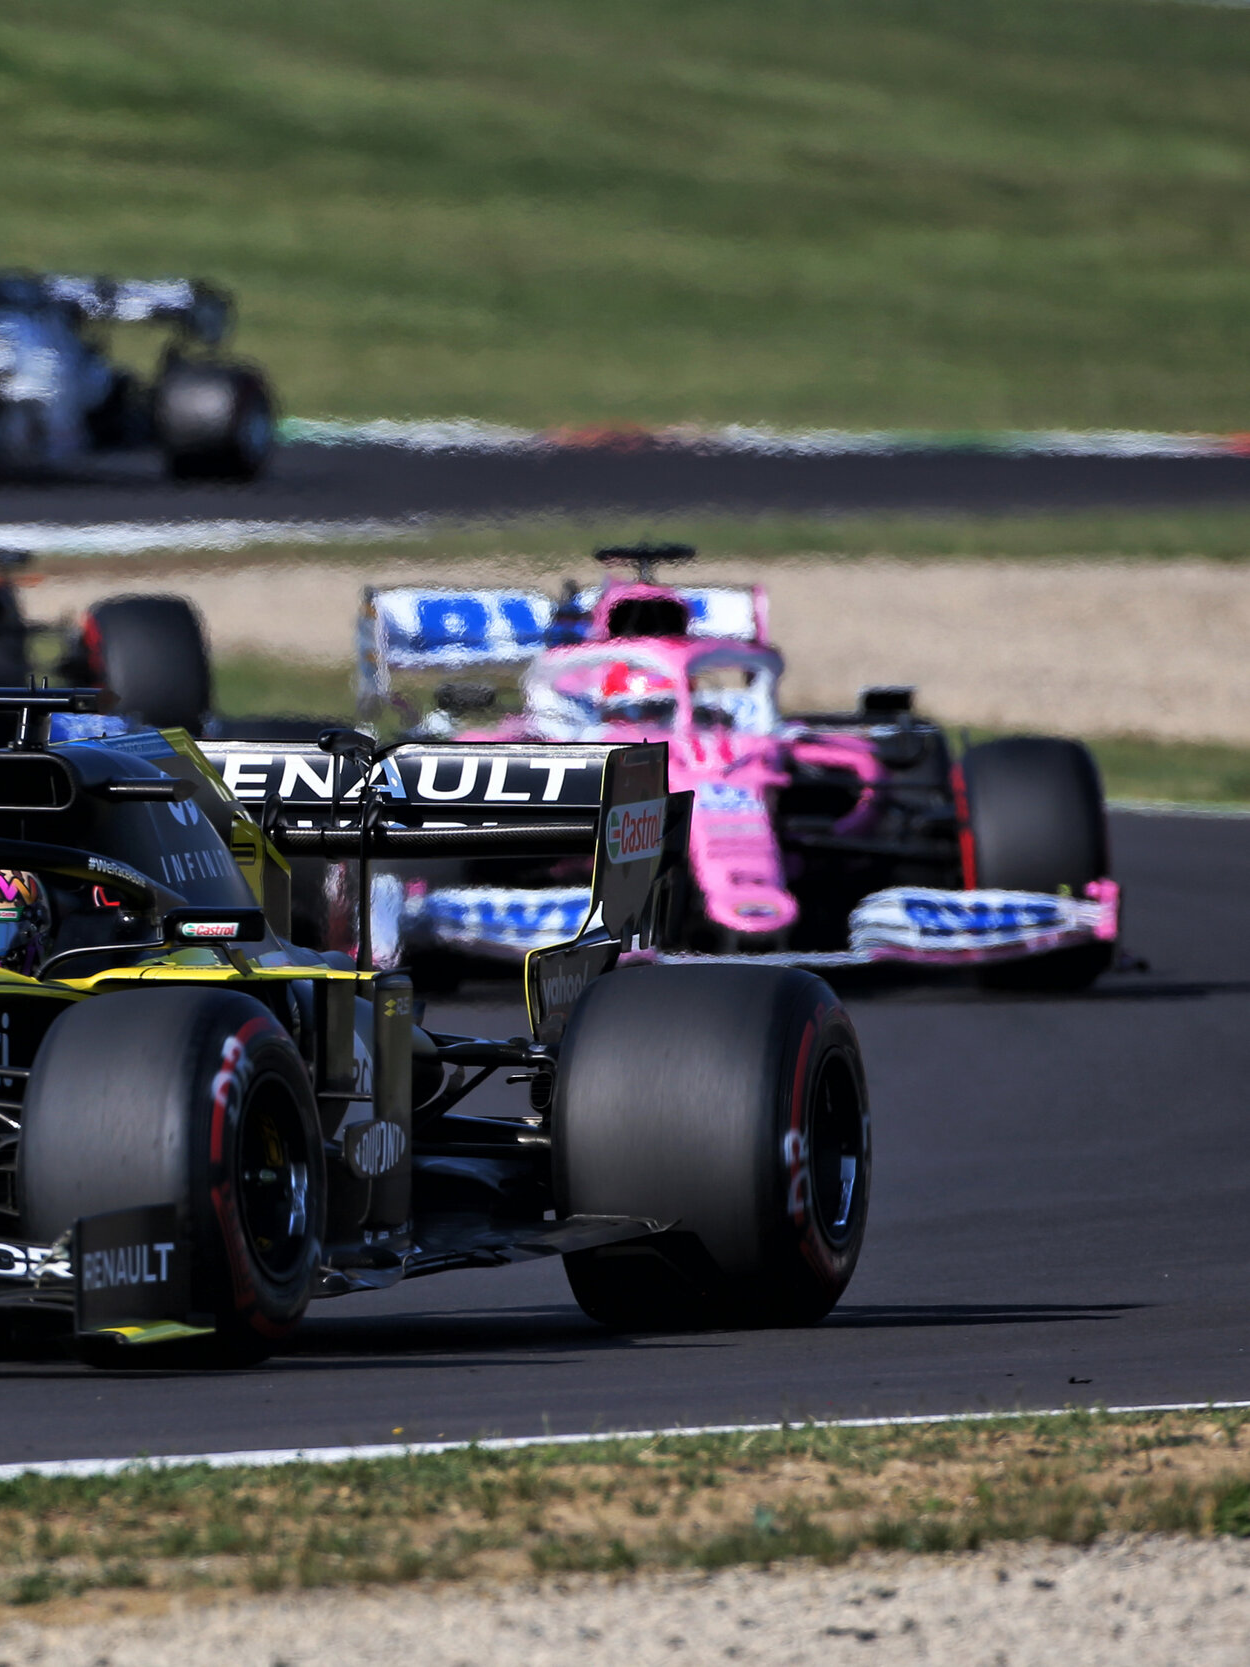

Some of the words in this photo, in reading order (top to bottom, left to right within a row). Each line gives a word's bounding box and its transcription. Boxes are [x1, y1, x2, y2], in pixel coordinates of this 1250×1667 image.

[223, 754, 587, 801] ENAULT
[621, 805, 663, 855] Castrol
[196, 925, 235, 936] Castrol
[83, 1242, 175, 1291] RENAULT
